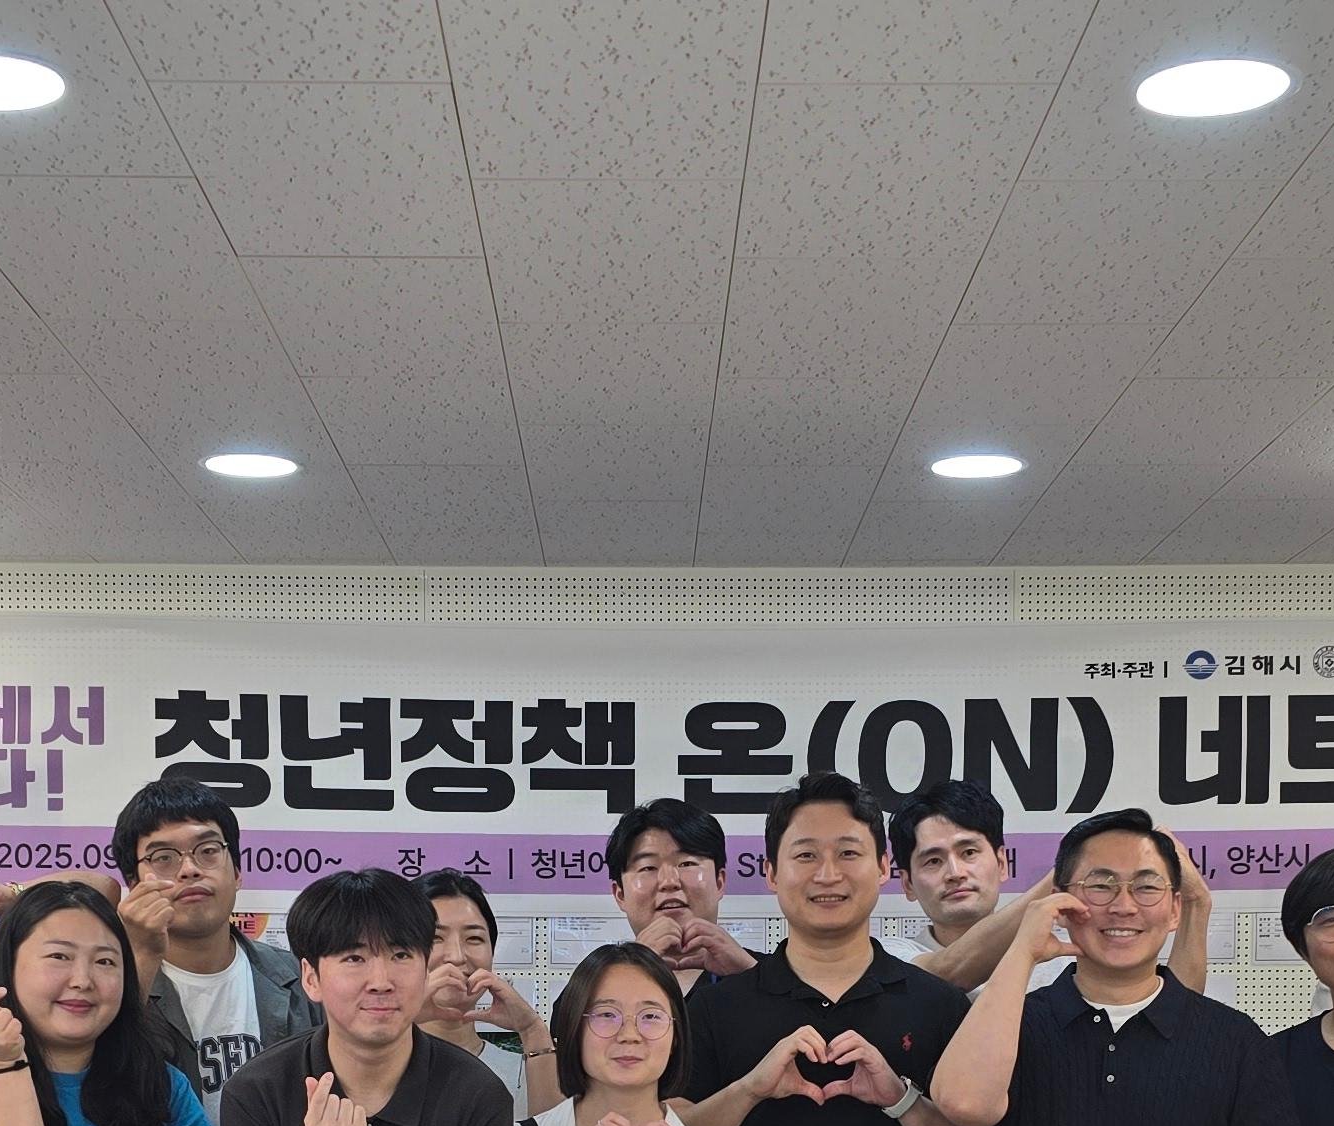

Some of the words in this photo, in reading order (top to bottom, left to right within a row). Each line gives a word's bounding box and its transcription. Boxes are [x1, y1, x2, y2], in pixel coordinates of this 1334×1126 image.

[153, 690, 637, 814] 청년정책
[530, 847, 613, 880] 청년어
[737, 852, 768, 878] St
